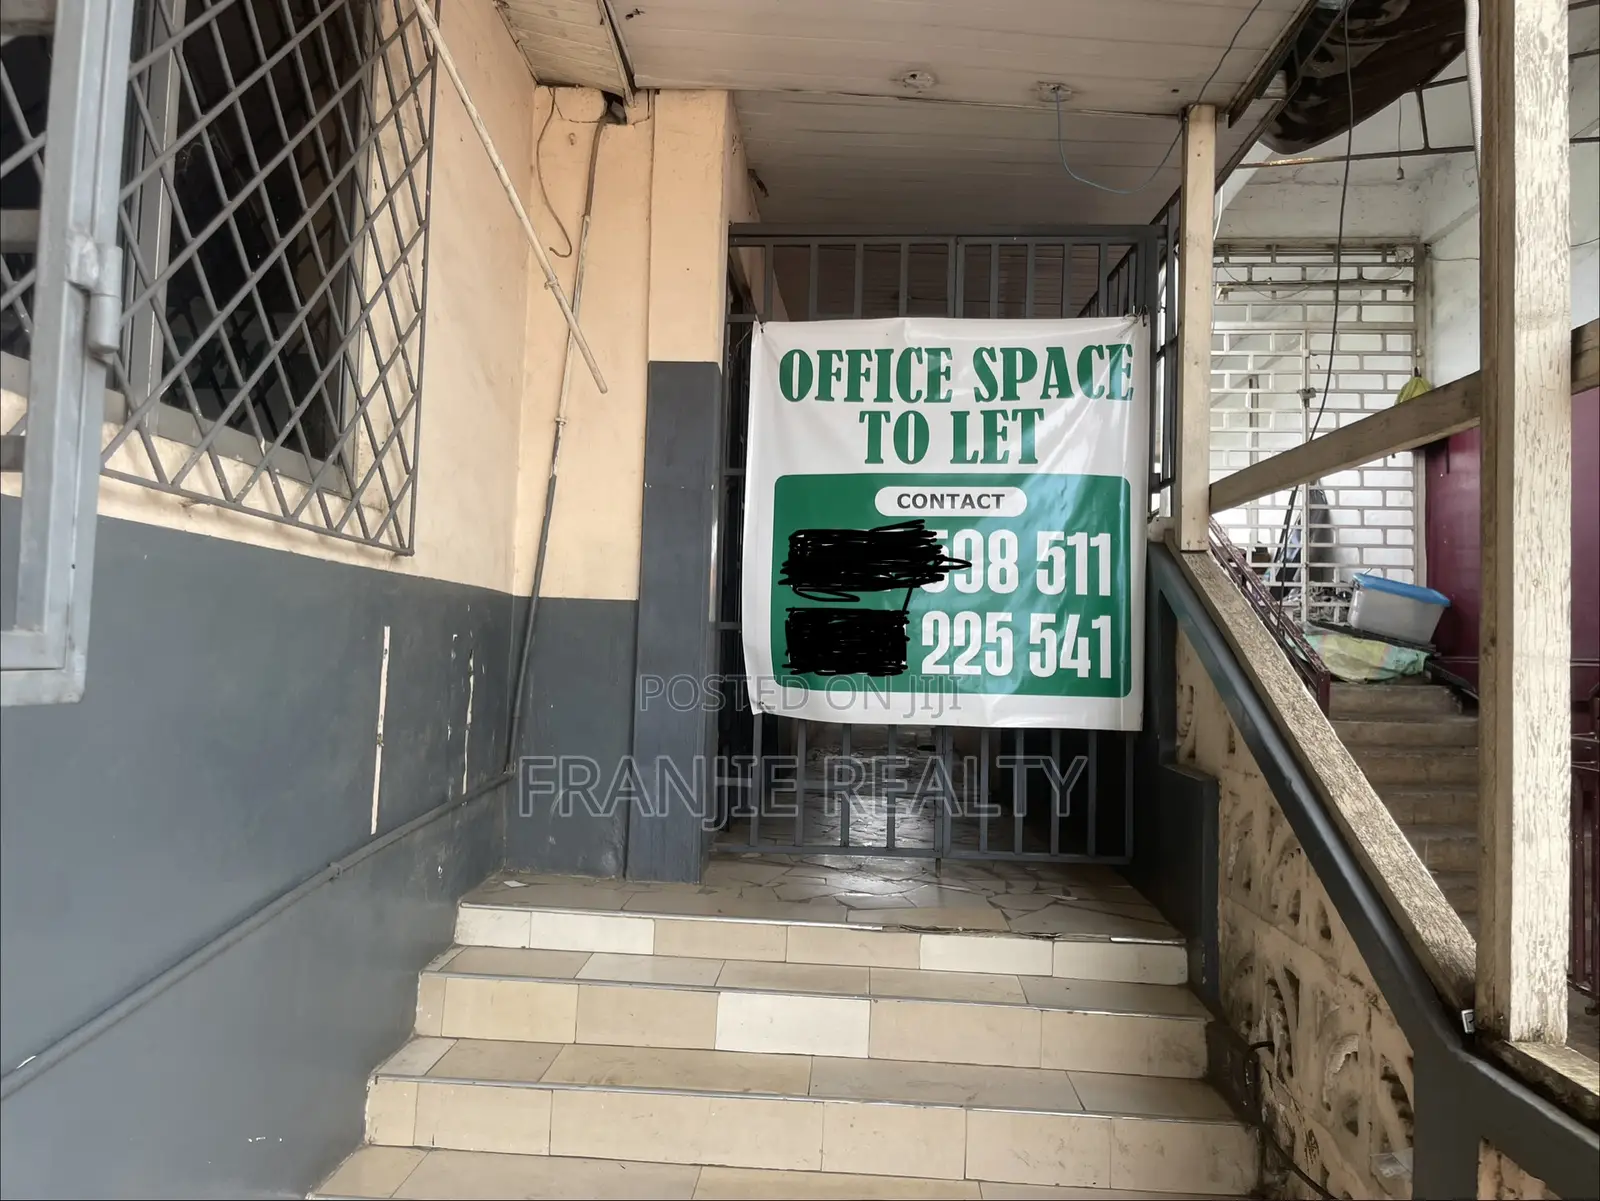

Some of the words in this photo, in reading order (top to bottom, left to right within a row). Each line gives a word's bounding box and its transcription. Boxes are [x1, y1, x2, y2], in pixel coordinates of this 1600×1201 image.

[779, 347, 952, 403] OFFICE
[972, 344, 1134, 402] SPACE
[859, 410, 929, 464] TO
[950, 408, 1045, 464] LET
[896, 493, 1005, 510] CONTACT
[1036, 531, 1112, 596] 511
[921, 611, 1013, 675] 225
[1029, 612, 1112, 679] 541
